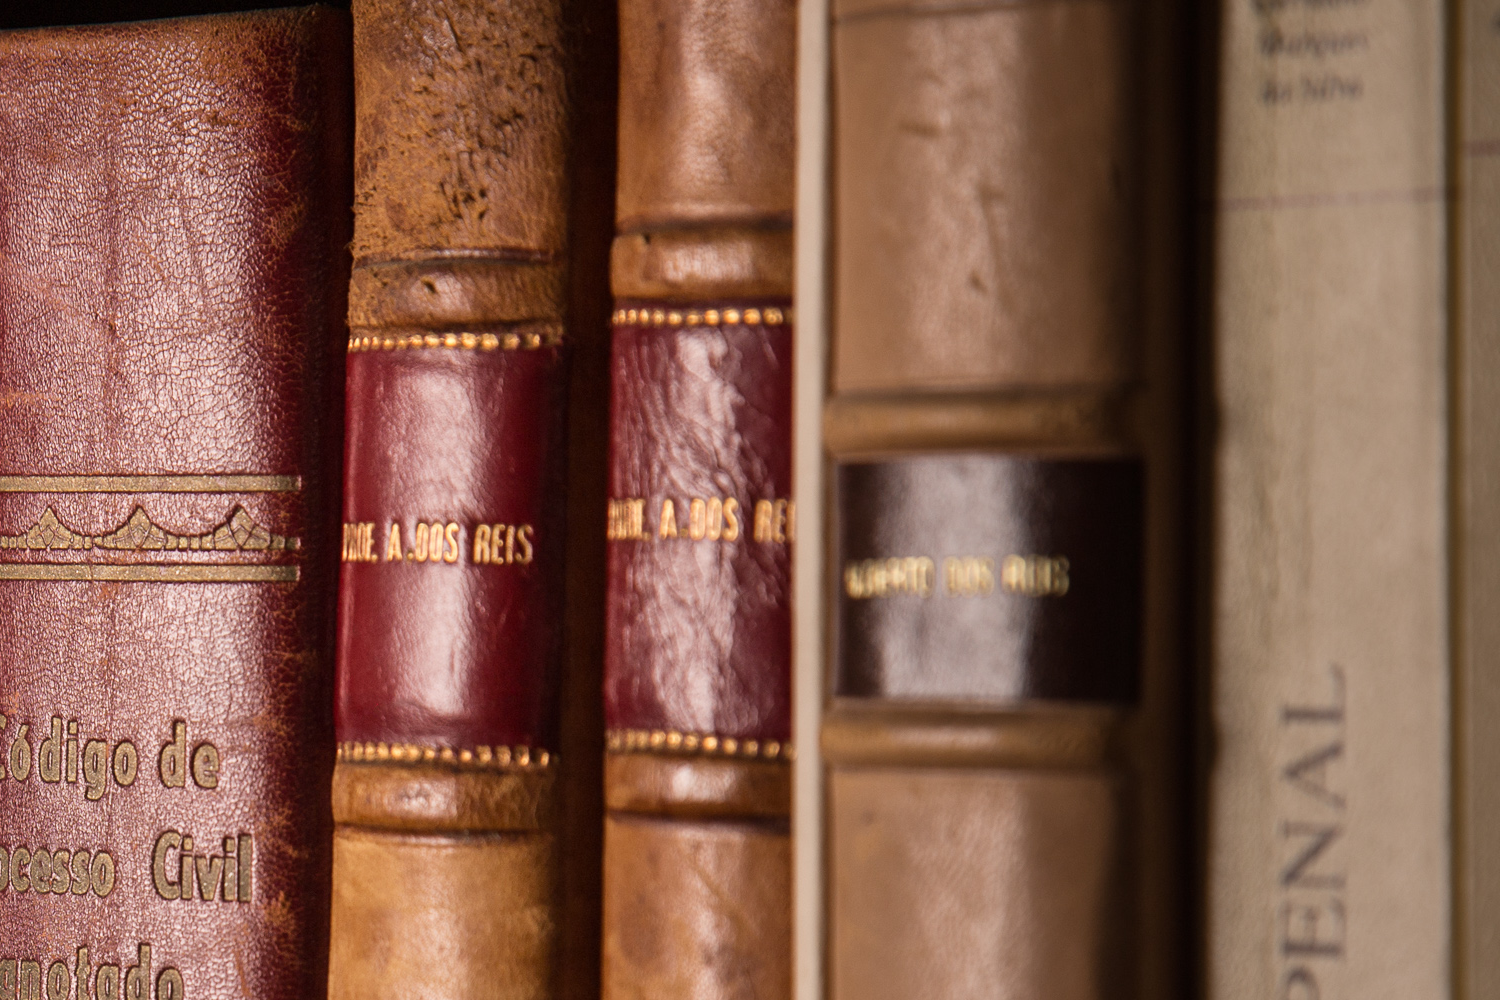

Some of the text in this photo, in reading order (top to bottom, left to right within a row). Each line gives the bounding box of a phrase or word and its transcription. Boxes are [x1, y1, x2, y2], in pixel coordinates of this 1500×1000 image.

[473, 523, 534, 564] REIS
[753, 499, 797, 543] REI
[160, 719, 220, 790] de
[151, 830, 253, 903] Civil
